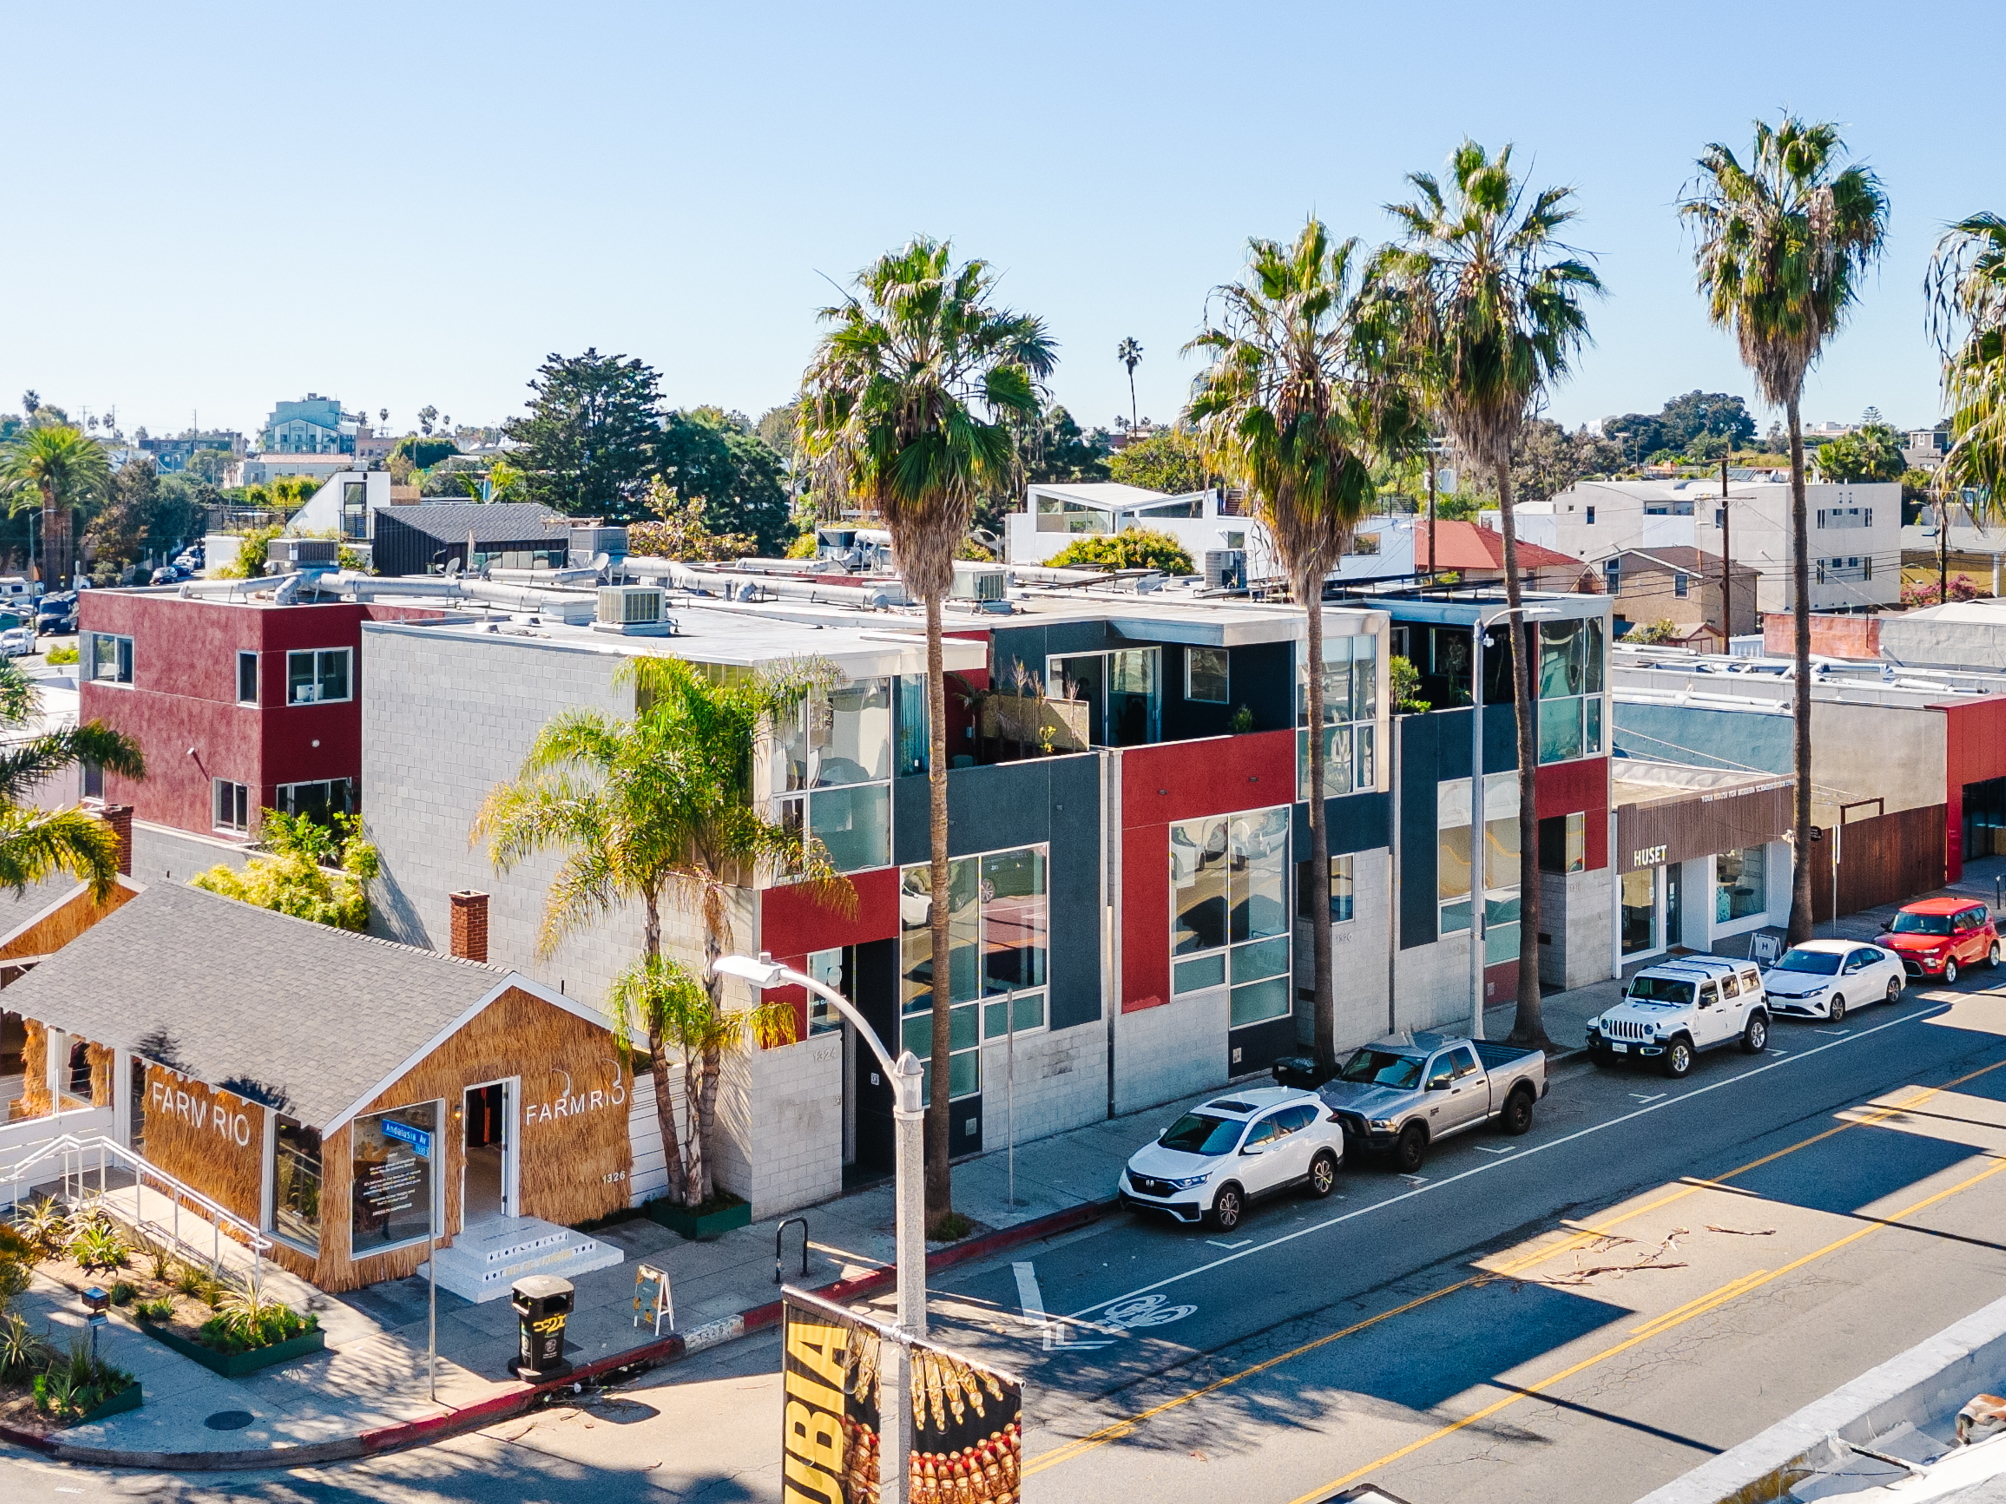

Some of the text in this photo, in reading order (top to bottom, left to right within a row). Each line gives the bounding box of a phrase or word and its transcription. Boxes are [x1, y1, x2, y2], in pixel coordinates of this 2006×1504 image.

[1633, 844, 1667, 867] HUSET
[1761, 941, 1769, 951] H
[152, 1081, 250, 1147] FARM RIO
[526, 1085, 626, 1126] FARM RIO
[385, 1123, 417, 1141] Andalusia
[602, 1170, 626, 1184] 1326
